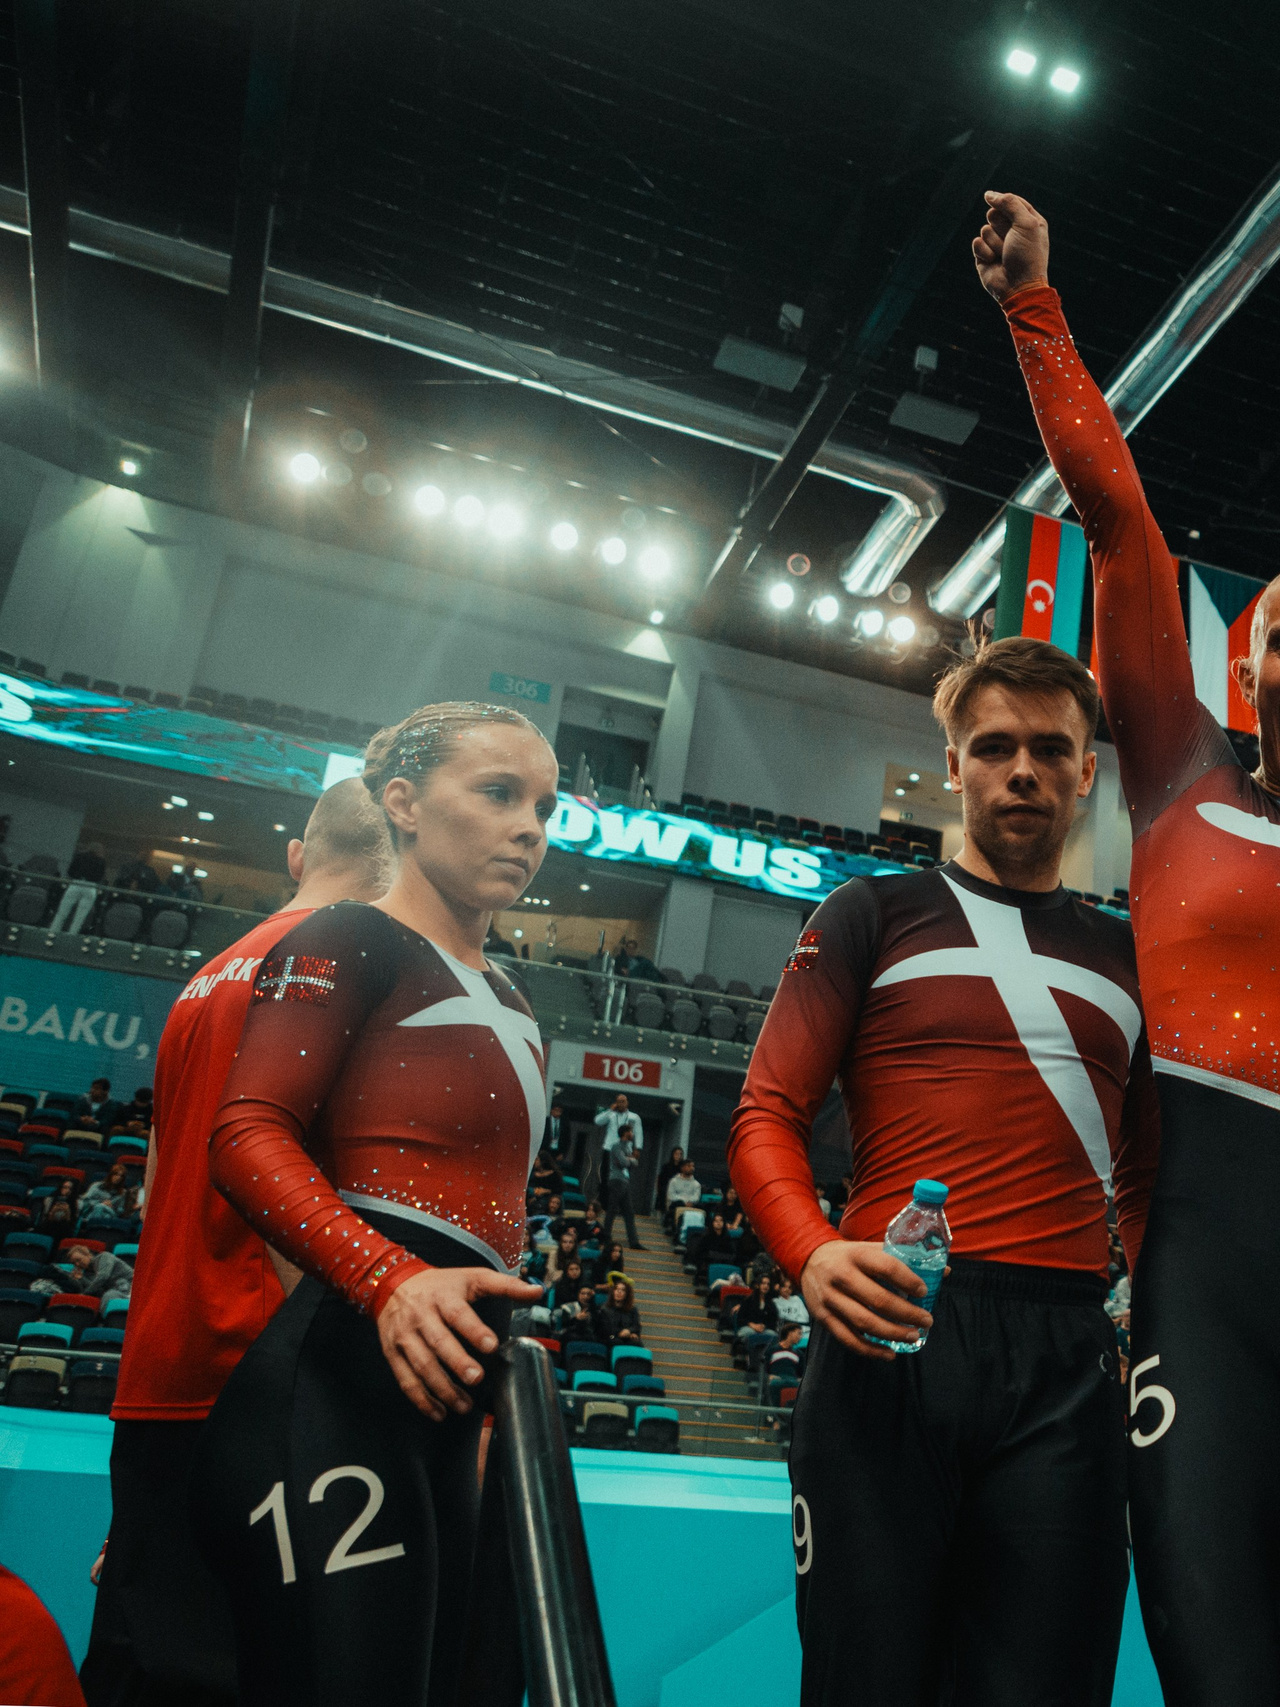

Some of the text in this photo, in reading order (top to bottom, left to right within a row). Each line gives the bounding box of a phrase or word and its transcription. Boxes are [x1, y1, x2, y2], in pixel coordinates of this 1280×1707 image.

[503, 677, 538, 698] 306
[709, 833, 821, 889] US
[0, 995, 150, 1060] BAKU,
[602, 1058, 644, 1083] 106
[1129, 1353, 1177, 1448] 5
[249, 1464, 406, 1586] 12
[792, 1494, 813, 1575] 9
